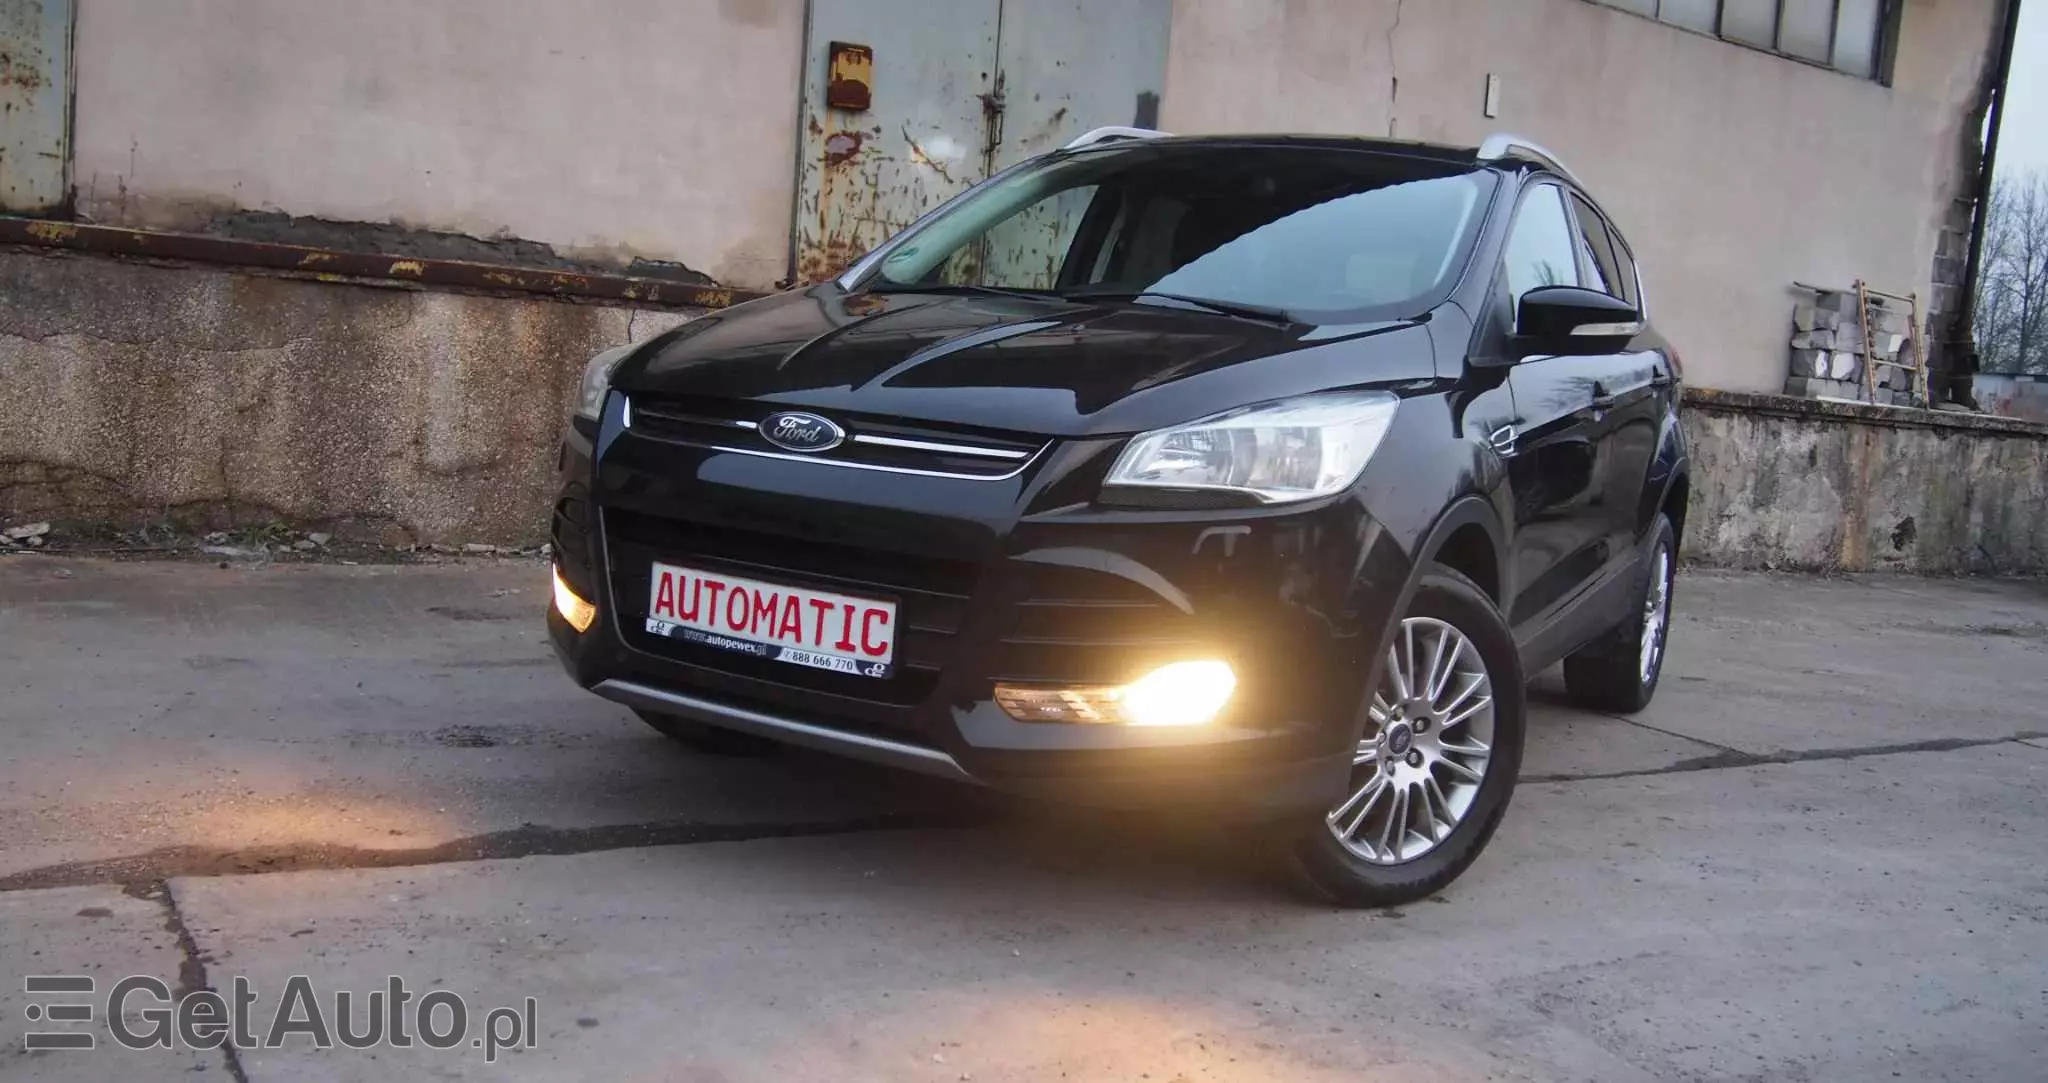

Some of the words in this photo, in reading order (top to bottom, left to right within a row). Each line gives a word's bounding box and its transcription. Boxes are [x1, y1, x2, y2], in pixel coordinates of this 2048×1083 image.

[774, 416, 822, 442] Ford
[655, 571, 889, 657] AUTOMATIC
[792, 651, 810, 664] 888
[813, 655, 832, 667] 666
[834, 659, 854, 671] 770
